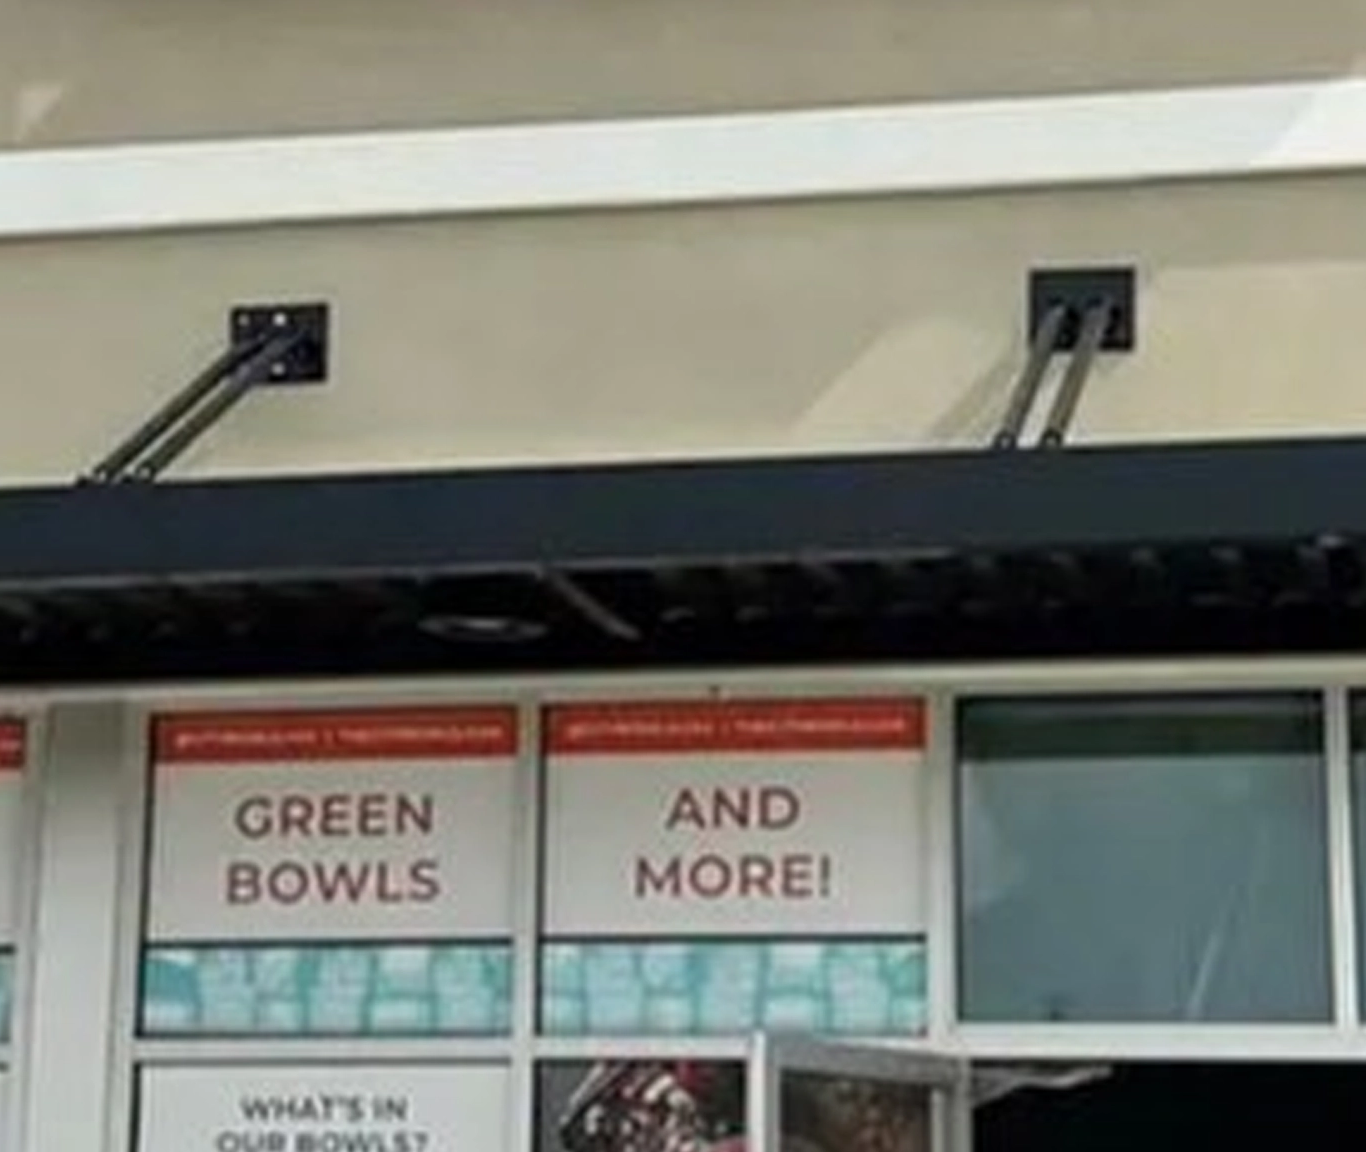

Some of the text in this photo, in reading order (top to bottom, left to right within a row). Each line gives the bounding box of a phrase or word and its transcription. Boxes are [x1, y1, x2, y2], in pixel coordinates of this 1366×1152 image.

[234, 794, 435, 839] GREEN
[665, 787, 801, 832] AND
[225, 860, 441, 906] BOWLS
[635, 854, 832, 900] MORE!
[240, 1094, 409, 1122] WHAT'S IN
[216, 1131, 286, 1152] OUR
